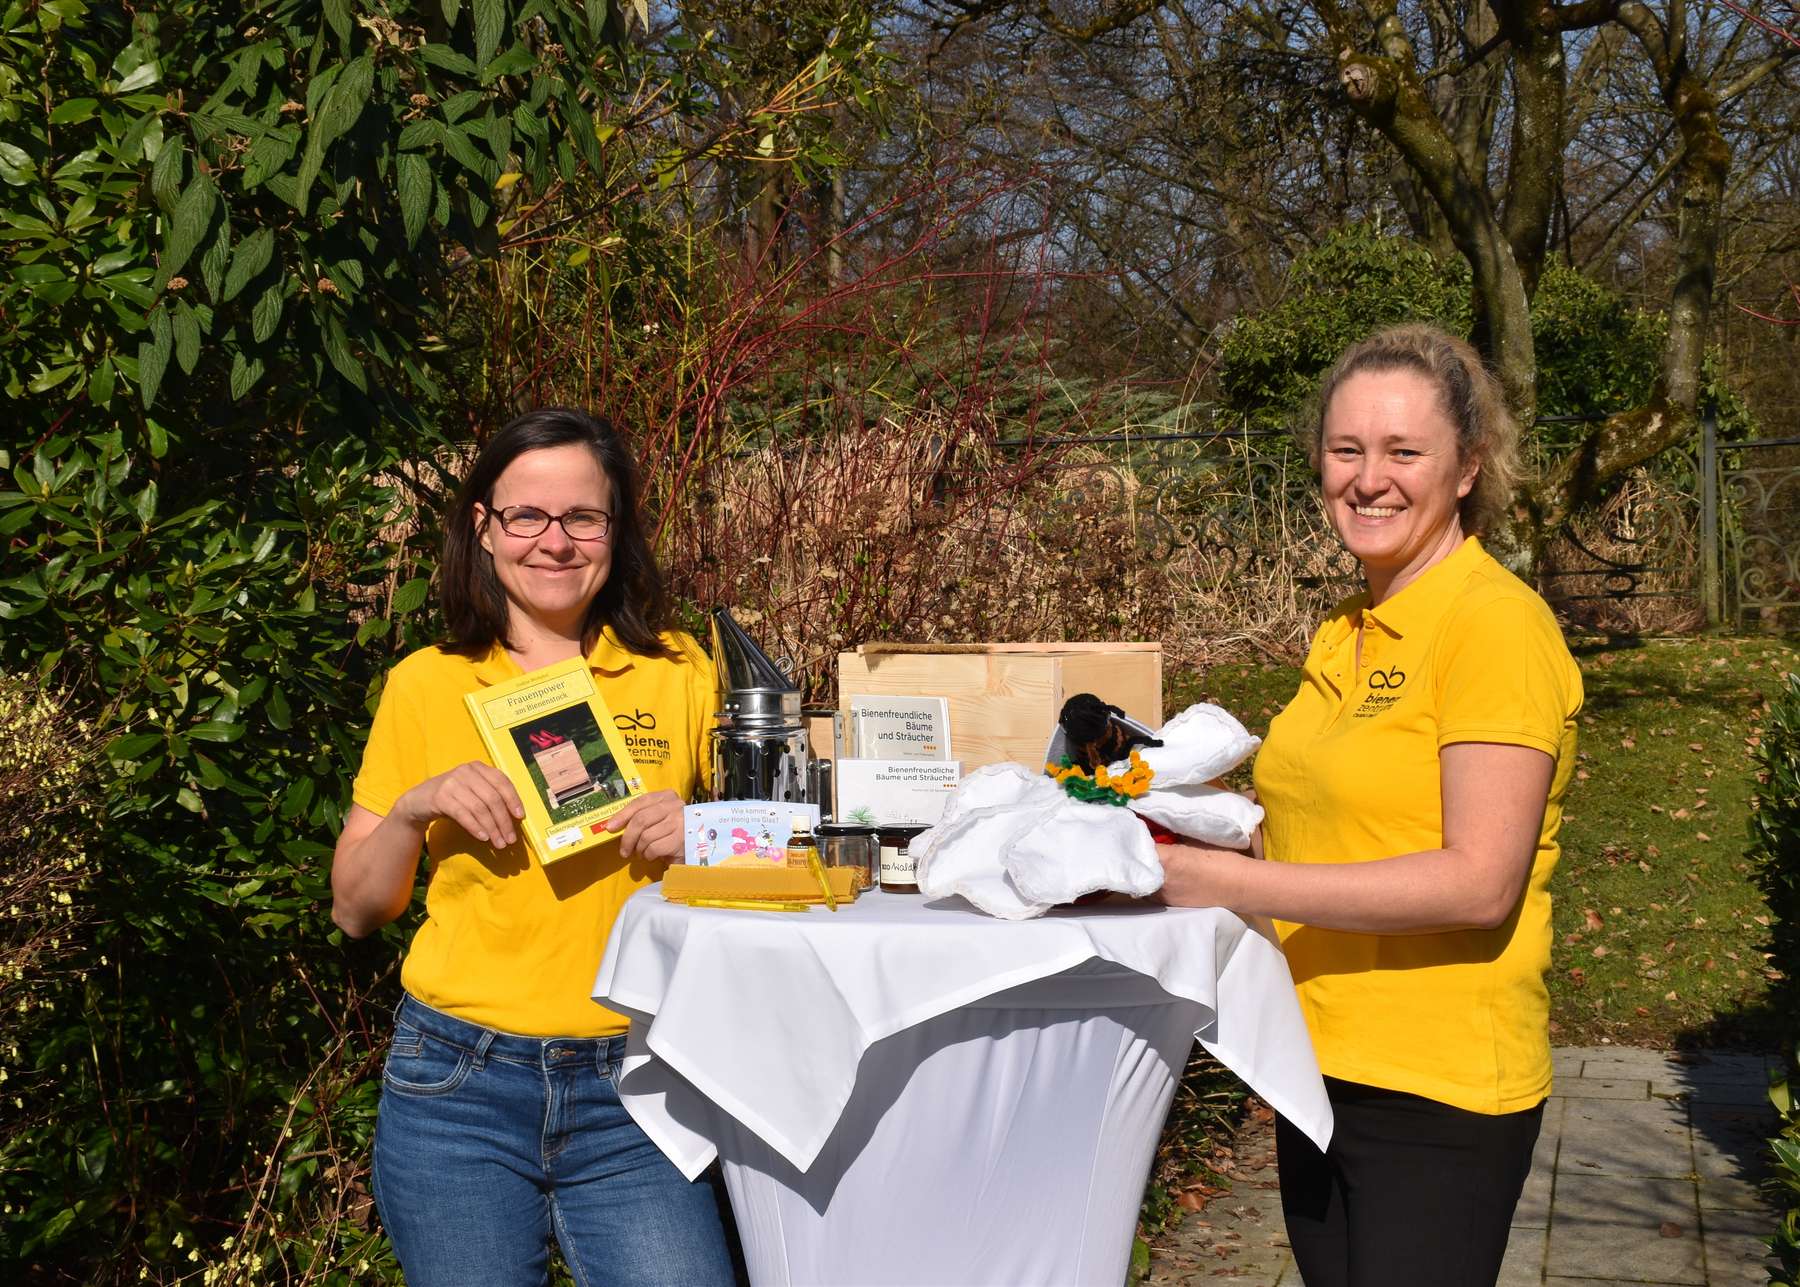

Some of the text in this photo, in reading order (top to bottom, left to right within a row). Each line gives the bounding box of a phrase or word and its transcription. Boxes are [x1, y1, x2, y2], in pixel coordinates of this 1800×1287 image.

[507, 681, 566, 707] Frauenpower
[526, 693, 569, 711] Bienenstock
[861, 708, 933, 721] Bienenfreundliche
[906, 721, 933, 732] Bäume
[624, 734, 670, 750] bienen
[878, 731, 934, 742] und Sträucher
[888, 766, 955, 774] Bienenfreundliche
[876, 773, 901, 781] Bäume
[919, 774, 955, 782] Sträucher
[718, 816, 730, 824] der
[731, 815, 750, 824] Honig
